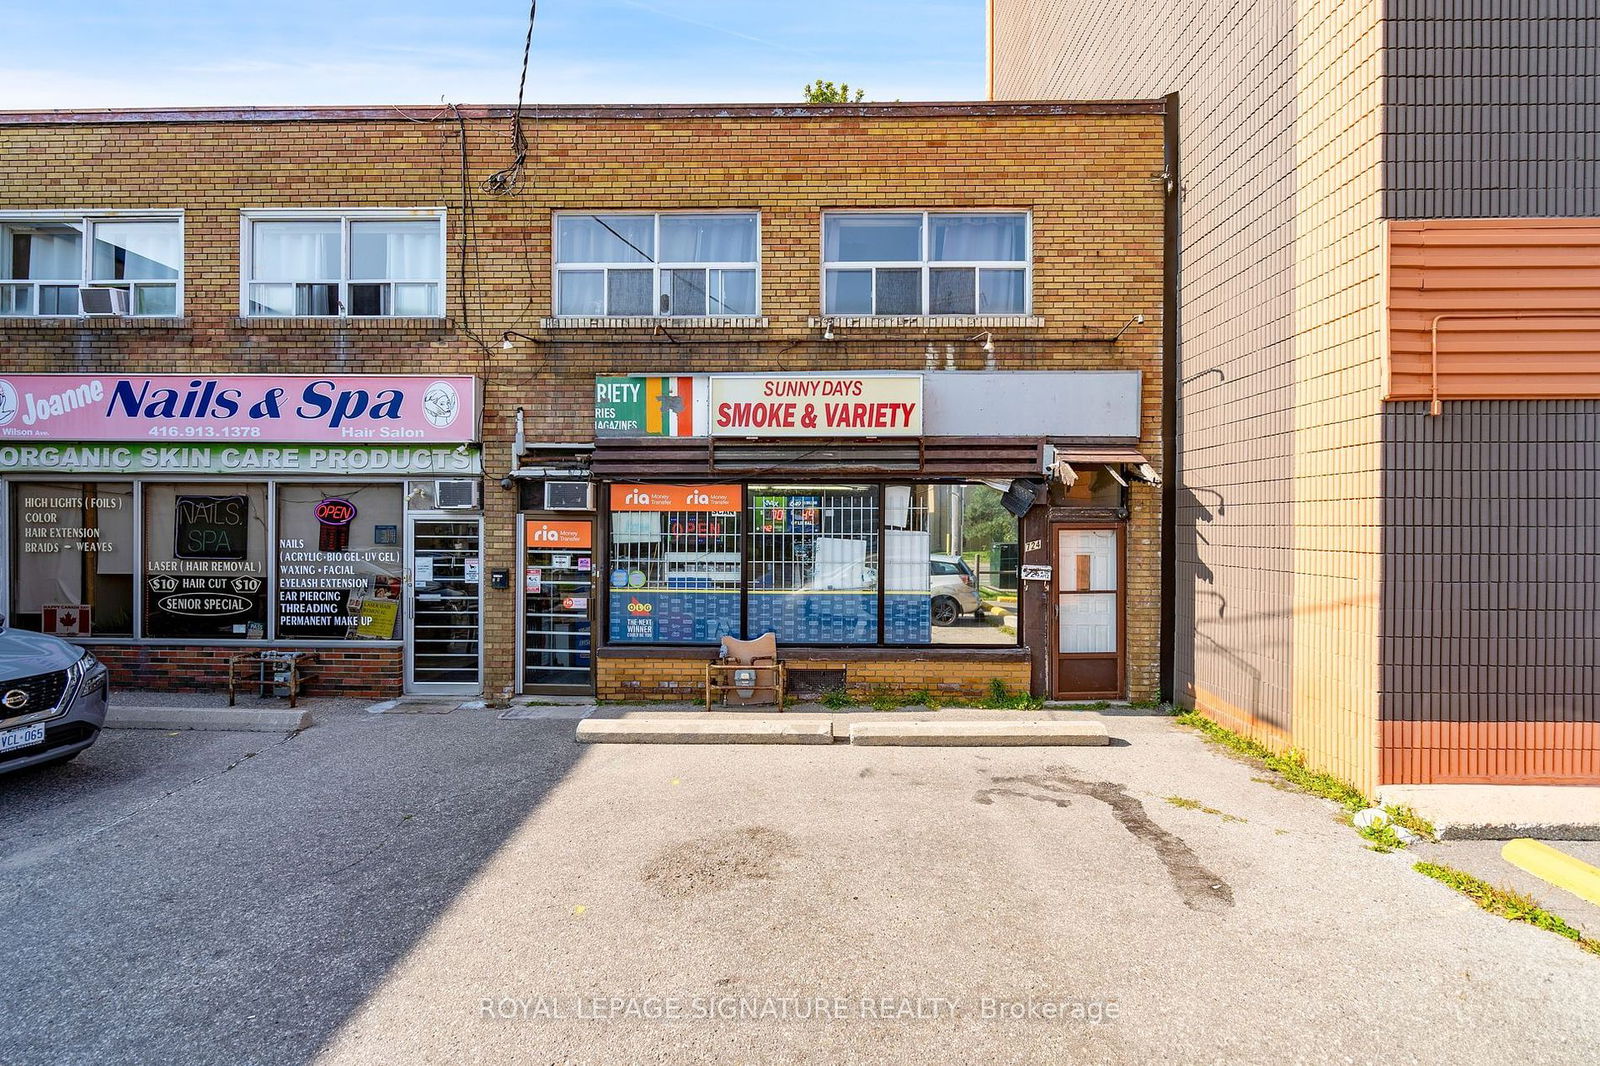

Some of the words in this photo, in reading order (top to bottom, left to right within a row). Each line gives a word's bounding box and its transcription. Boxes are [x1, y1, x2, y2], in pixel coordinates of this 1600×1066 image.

[764, 381, 820, 397] SUNNY
[822, 380, 863, 397] DAYS
[22, 379, 104, 425] Joanne
[106, 380, 242, 418] Nails
[249, 388, 288, 419] &
[296, 381, 404, 428] Spa
[595, 407, 616, 419] RIES
[716, 402, 796, 429] SMOKE
[800, 403, 818, 429] &
[823, 402, 917, 429] VARIETY
[2, 428, 33, 436] Wilson
[149, 426, 261, 438] 416.913.1378
[341, 427, 375, 438] Hair
[379, 427, 425, 438] Salon
[0, 447, 131, 468] ORGANIC
[141, 447, 212, 468] SKIN
[221, 448, 299, 469] CARE
[310, 448, 470, 470] PRODUCTS
[625, 488, 650, 505] ria
[686, 489, 709, 505] ria
[24, 498, 49, 509] HIGH
[50, 498, 83, 509] LIGHTS
[317, 505, 352, 519] OPEN
[25, 513, 57, 523] COLOR
[24, 528, 47, 538] HAIR
[49, 527, 100, 538] EXTENSION
[534, 525, 559, 541] ria
[188, 529, 232, 552] SPA
[280, 539, 304, 549] NAILS
[1026, 541, 1041, 550] 724
[24, 542, 59, 553] BRAIDS
[76, 542, 113, 552] WEAVES
[149, 561, 177, 572] LASER
[280, 565, 316, 575] WAXING
[323, 565, 355, 575] FACIAL
[153, 578, 175, 590] $10
[182, 578, 206, 589] HAIR
[208, 578, 227, 589] CUT
[235, 578, 258, 590] $10
[280, 578, 318, 588] EYELASH
[320, 578, 368, 588] EXTENSION
[280, 591, 297, 601] EAR
[299, 591, 341, 601] PIERCING
[166, 598, 201, 610] SENIOR
[203, 598, 244, 610] SPECIAL
[280, 603, 338, 613] THREADING
[280, 616, 331, 626] PERMANENT
[333, 616, 358, 626] MAKE
[360, 616, 373, 626] UP
